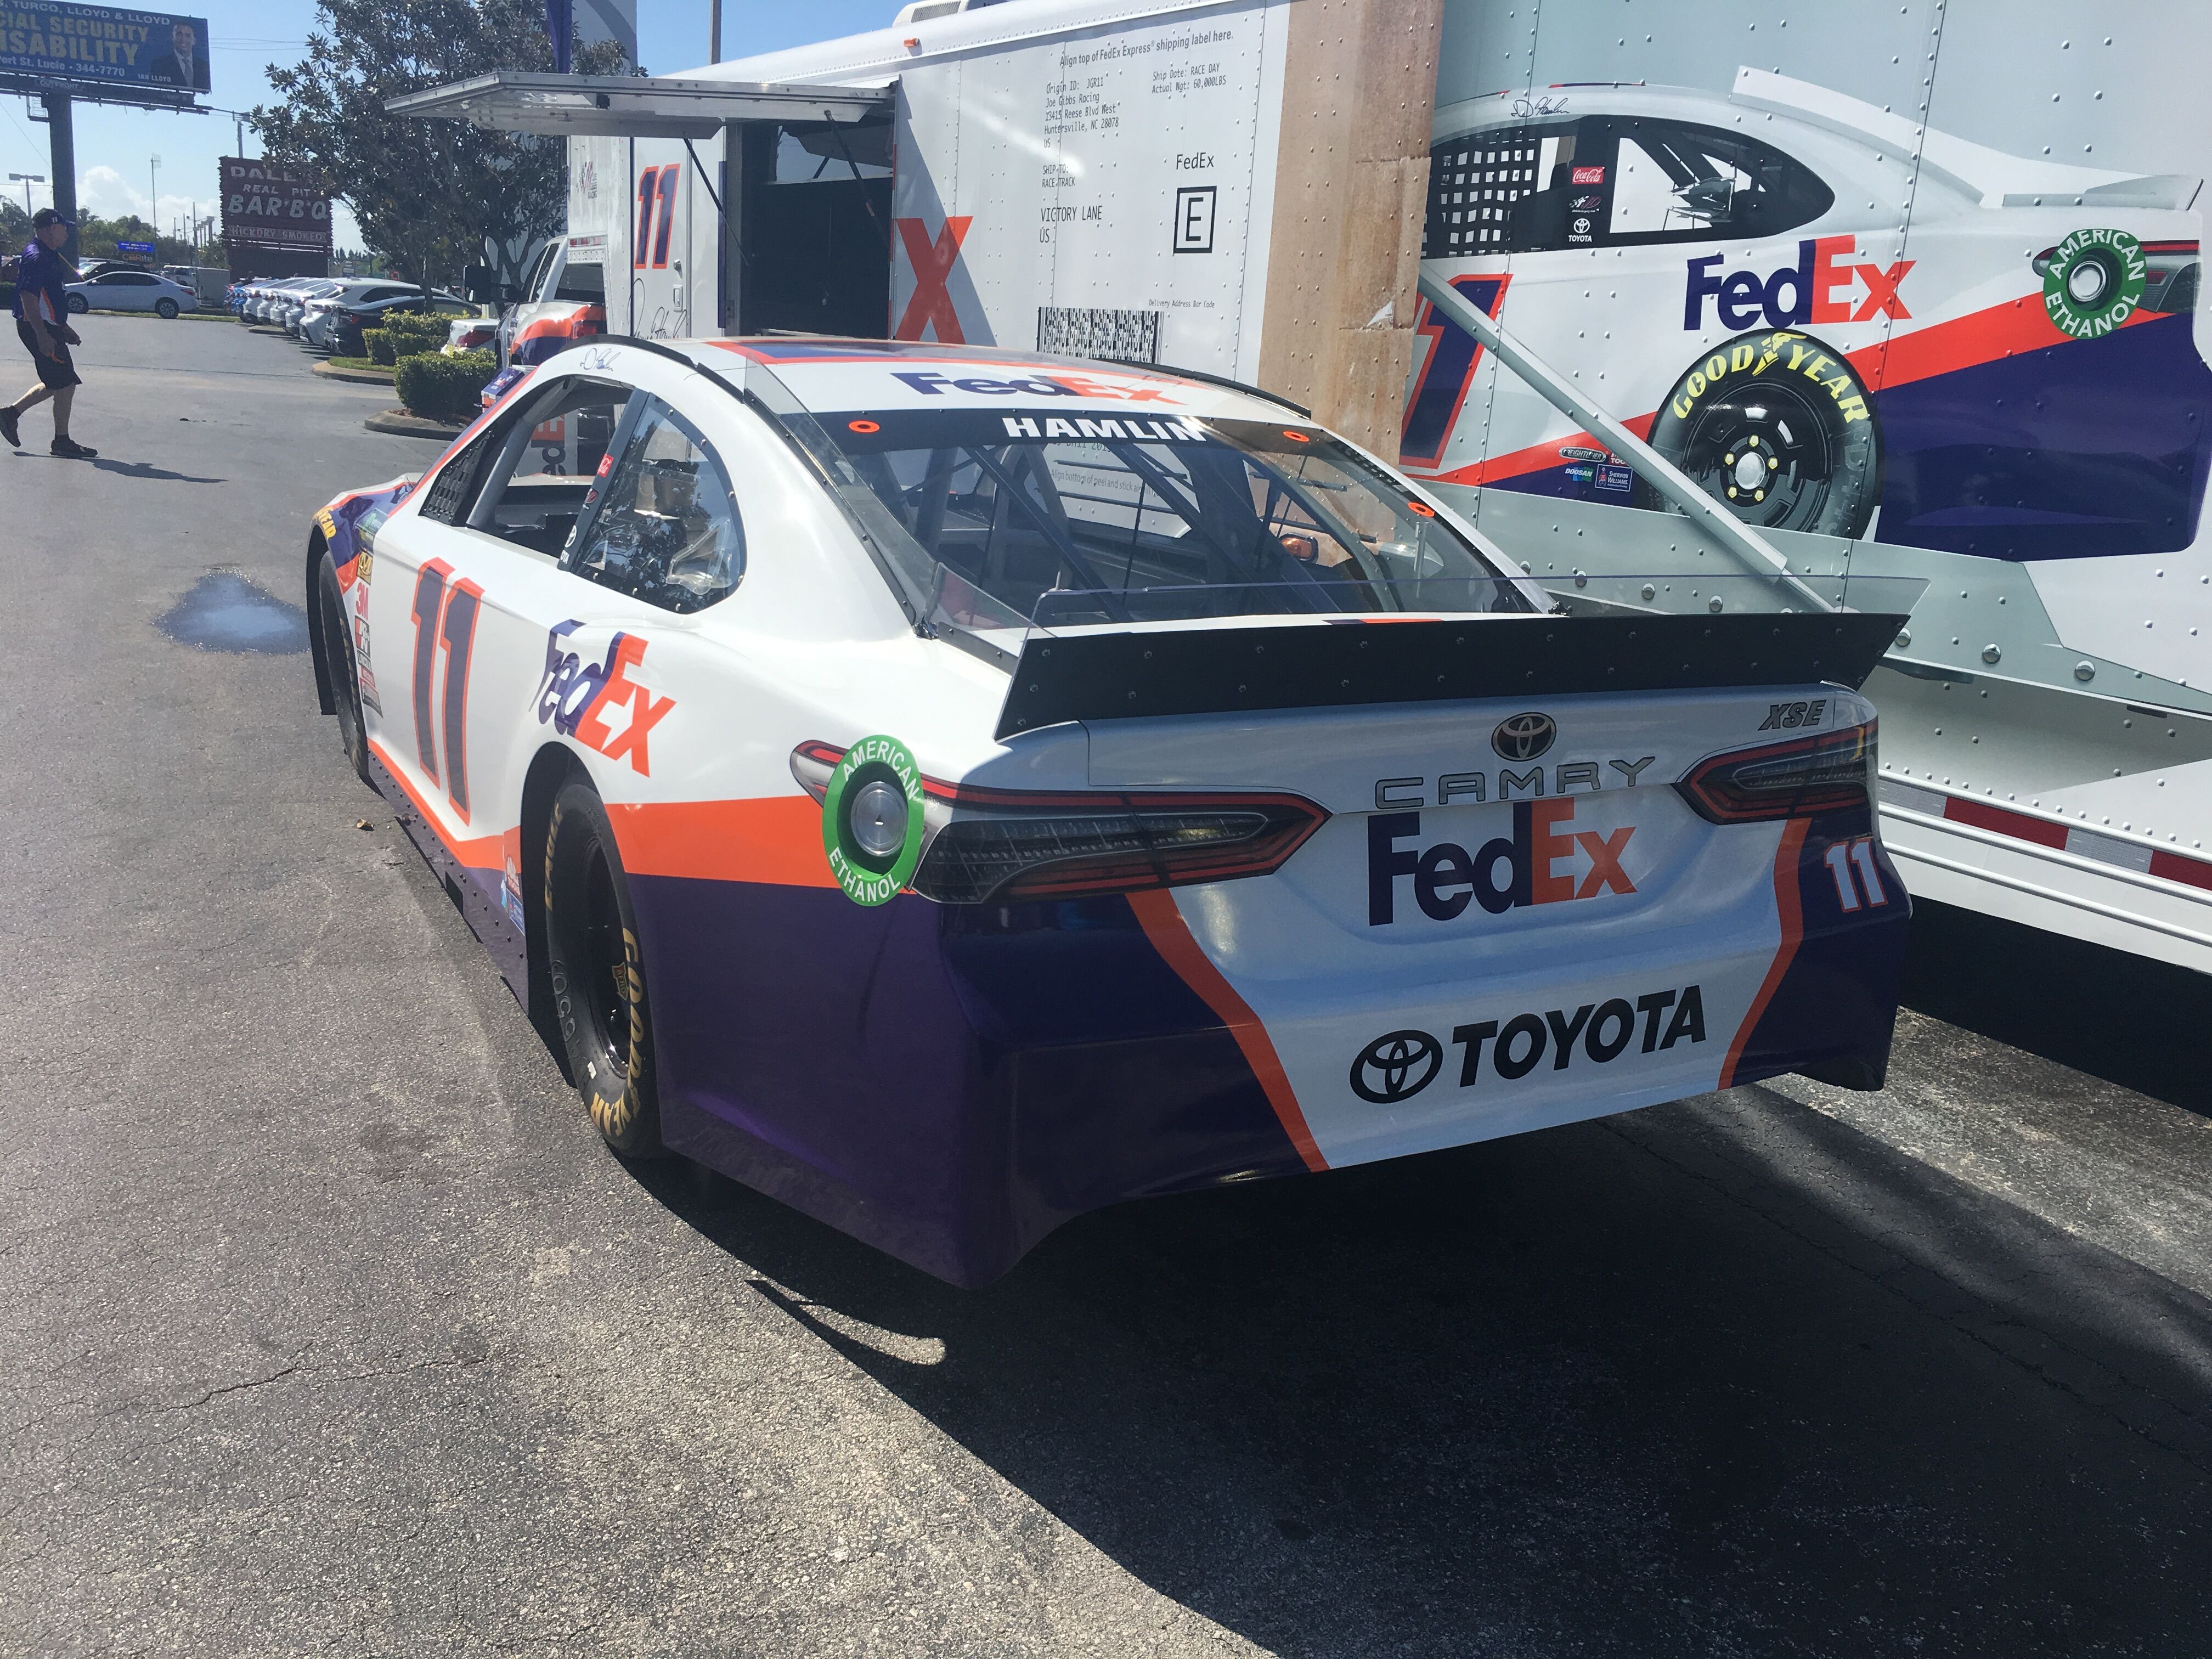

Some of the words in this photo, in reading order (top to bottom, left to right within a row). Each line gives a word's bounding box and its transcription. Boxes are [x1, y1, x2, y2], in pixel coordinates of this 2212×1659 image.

[13, 1, 63, 14] TURCO,
[67, 7, 110, 18] LLOYD
[128, 14, 171, 25] LLOYD
[0, 10, 41, 31] CIAL
[49, 16, 149, 43] SECURITY
[0, 29, 138, 66] ISABILITY
[1060, 55, 1077, 67] Align
[1079, 55, 1090, 65] top
[1092, 50, 1098, 61] of
[1100, 47, 1120, 60] FedEx
[1156, 36, 1189, 51] shipping
[1192, 31, 1211, 45] label
[1213, 30, 1233, 42] here.
[1, 55, 17, 65] ort
[37, 59, 66, 70] Lucie
[76, 63, 125, 77] 344-7770
[1153, 70, 1167, 82] Ship
[1170, 68, 1187, 80] Date:
[1190, 65, 1205, 76] RACE
[1209, 63, 1220, 74] DAY
[1046, 83, 1066, 95] Origin
[1070, 81, 1079, 91] ID:
[1087, 77, 1103, 88] JGR11
[1152, 82, 1172, 94] Actual
[1176, 81, 1189, 92] Wgt:
[1193, 75, 1226, 89] 60,000LBS
[1046, 98, 1056, 108] Joe
[1059, 95, 1076, 105] Gibbs
[1079, 92, 1099, 104] Racing
[1045, 110, 1061, 121] 13415
[1065, 109, 1082, 119] Reese
[1085, 105, 1099, 116] Blvd
[1102, 104, 1116, 114] West
[1045, 121, 1087, 134] Huntersville,
[1091, 119, 1098, 129] NC
[1101, 117, 1119, 129] 28078
[1044, 138, 1051, 148] US
[1043, 165, 1056, 174] SHIP
[1059, 164, 1068, 173] TO:
[1176, 152, 1215, 170] FedEx
[243, 184, 279, 194] REAL
[292, 188, 310, 197] PIT
[1042, 178, 1055, 188] RACE
[1058, 177, 1075, 187] TRACK
[634, 163, 680, 269] 11
[1041, 206, 1077, 222] VICTORY
[1082, 205, 1103, 221] LANE
[1186, 197, 1204, 241] E
[231, 227, 276, 238] HICKORY
[283, 230, 323, 240] SMOKED
[1040, 228, 1049, 243] US
[2050, 229, 2145, 281] AMERICAN
[1684, 234, 1917, 331] FedEx
[1149, 299, 1170, 308] Delivery
[1172, 300, 1191, 308] Address
[2045, 291, 2140, 337] ETHANOL
[890, 373, 1189, 405] FedEx
[1002, 417, 1207, 442] HAMLIN
[1051, 469, 1064, 480] Align
[1065, 471, 1086, 483] bottom
[1094, 477, 1107, 486] peel
[1119, 482, 1133, 491] stick
[1565, 468, 1593, 477] DOOSAN
[411, 557, 486, 827] 11
[528, 619, 677, 777] FedEx
[1758, 699, 1827, 731] XSE
[843, 740, 920, 801] AMERICAN
[1375, 756, 1656, 810] CAMRY
[1368, 797, 1638, 926] FedEx
[829, 847, 900, 902] ETHANOL
[1824, 837, 1888, 913] 11
[1452, 984, 1706, 1087] TOYOTA
